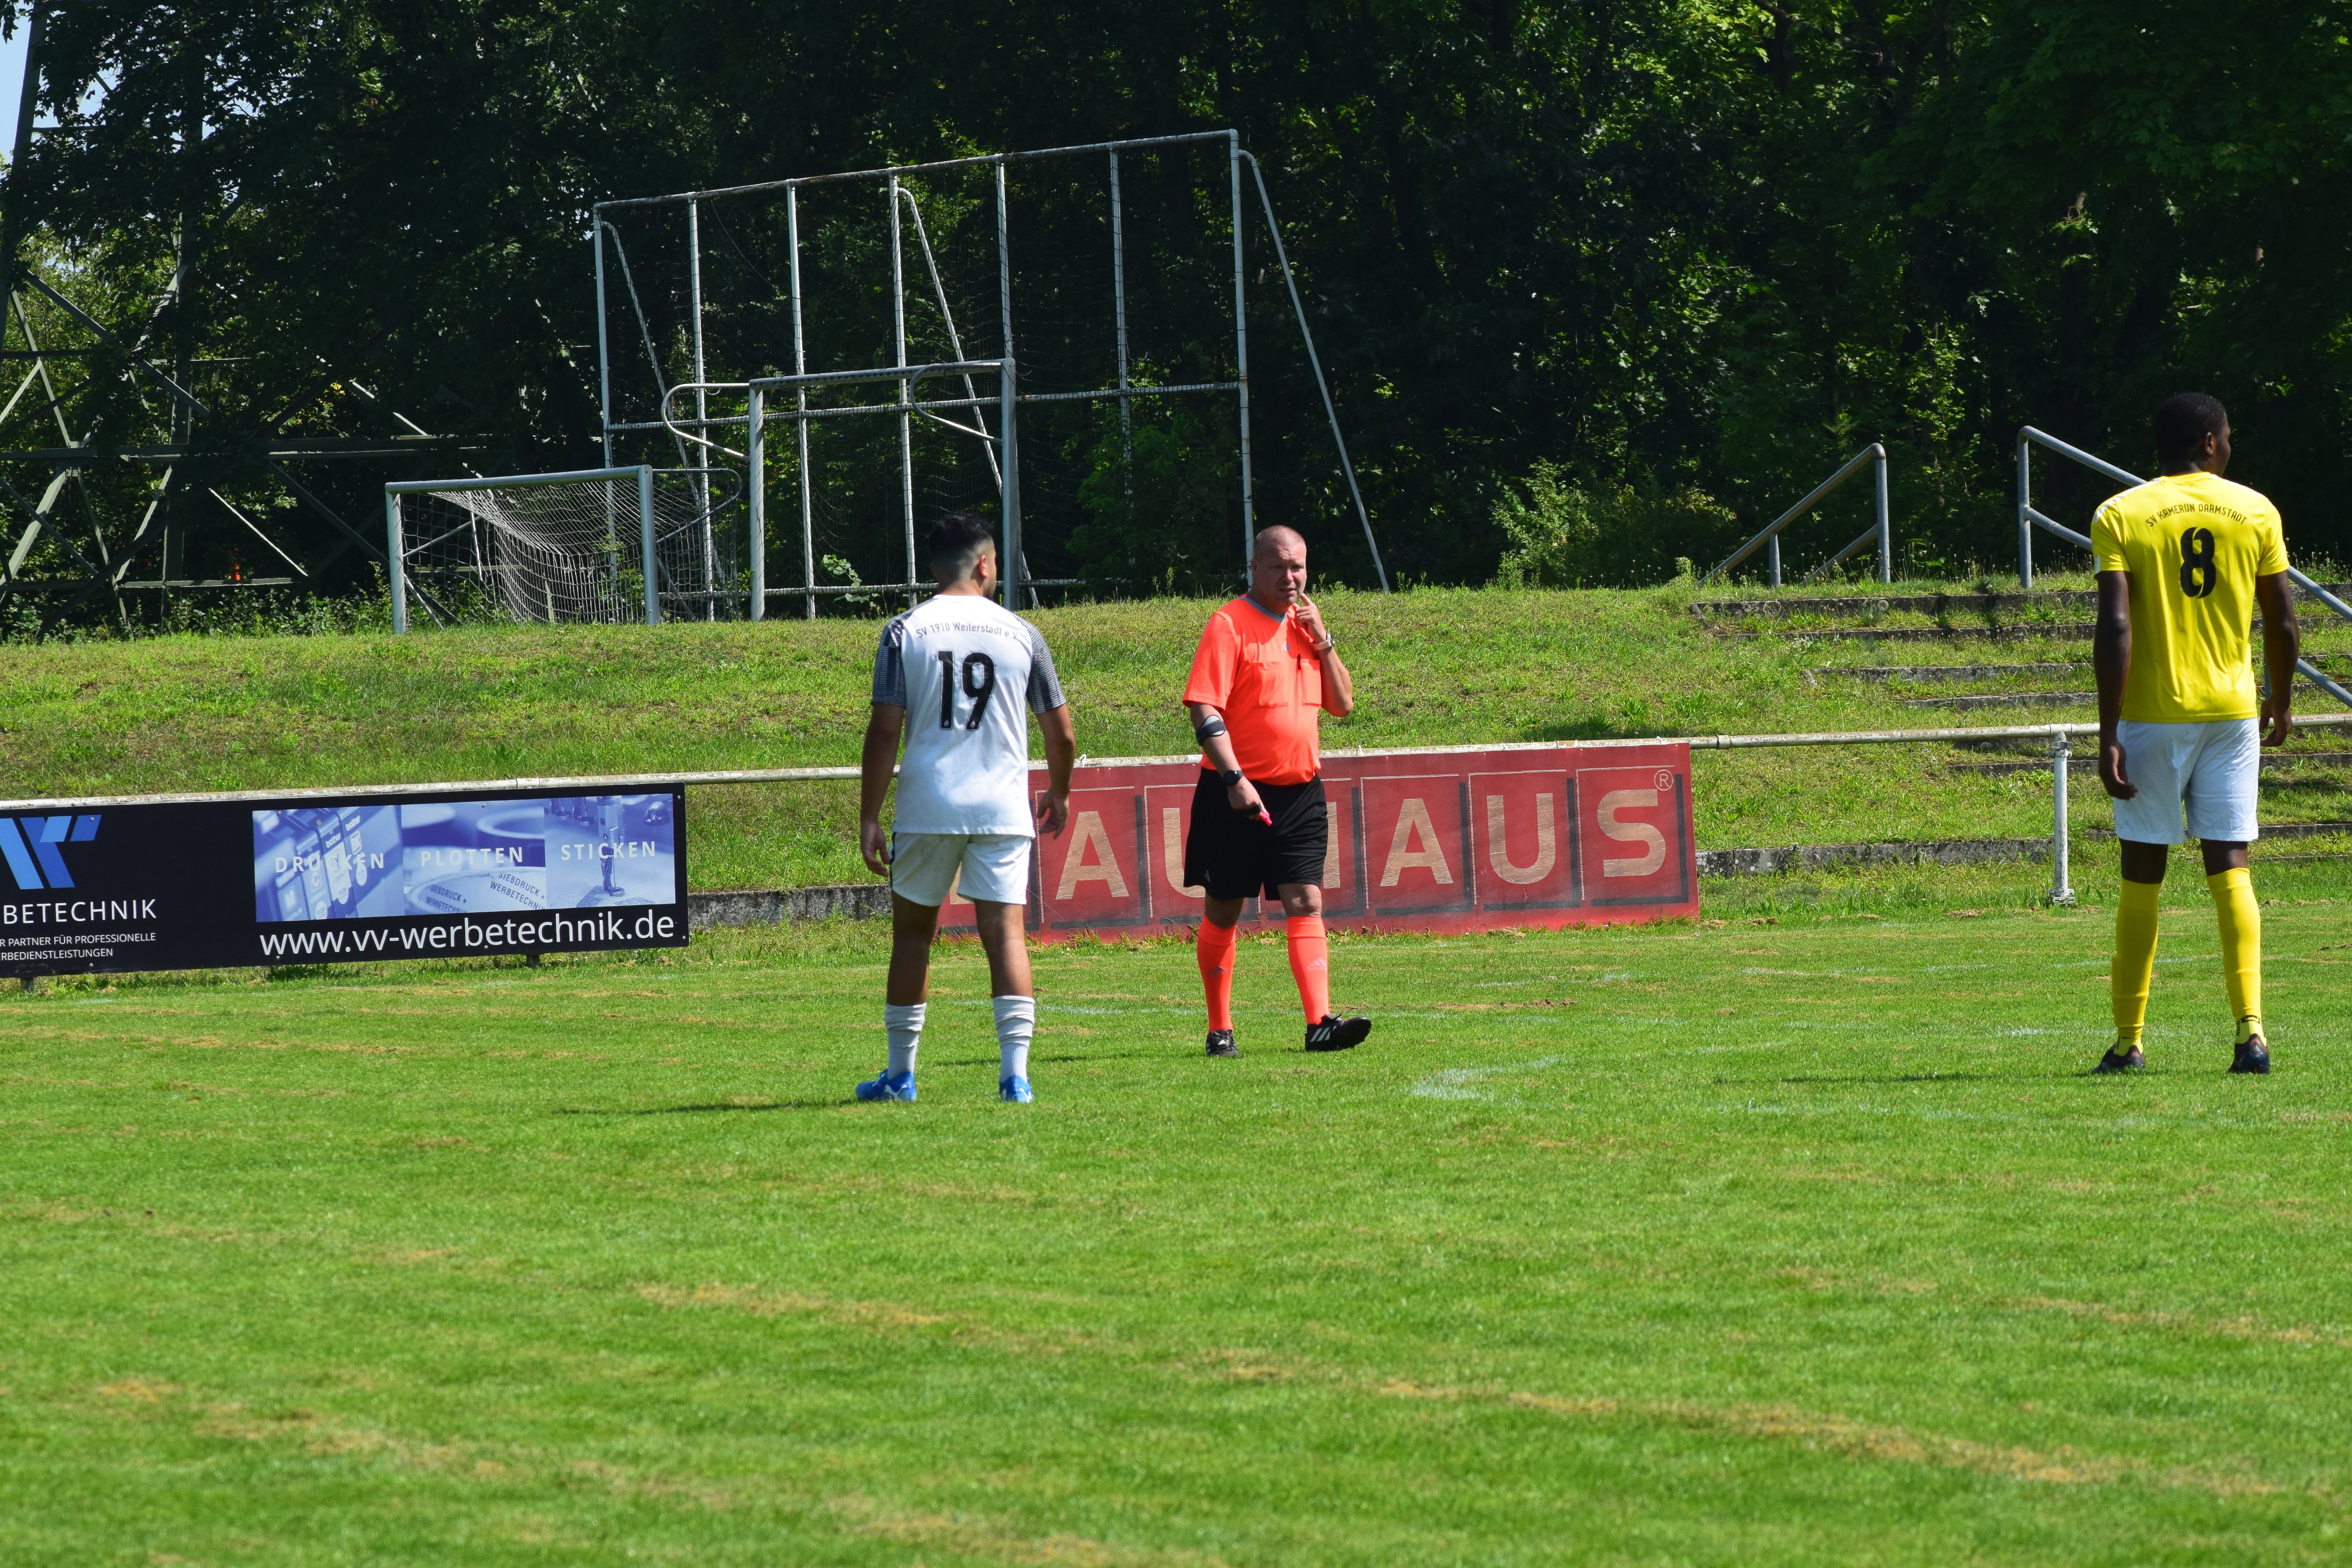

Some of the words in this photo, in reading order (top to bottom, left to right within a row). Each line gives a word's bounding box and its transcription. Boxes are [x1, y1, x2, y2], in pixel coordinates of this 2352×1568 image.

[2146, 515, 2158, 527] SV
[2157, 503, 2195, 520] KAMERUN
[2199, 504, 2247, 524] DARMSTADT
[2180, 526, 2216, 599] 8
[916, 627, 927, 638] SV
[930, 622, 950, 633] 1910
[953, 622, 1002, 635] Weiterstadt
[936, 649, 995, 731] 19
[421, 847, 523, 866] PLOTTEN
[561, 841, 655, 860] STICKEN
[949, 788, 1666, 905] AUAUS
[4, 899, 156, 924] BETECHNIK
[8, 937, 51, 946] PARTNER
[54, 935, 73, 945] FÜR
[75, 933, 156, 944] PROFESSIONELLE
[260, 910, 673, 956] www.vv-werbetechnik.de
[0, 948, 113, 961] RBEDIENSTLEISTUNGEN
